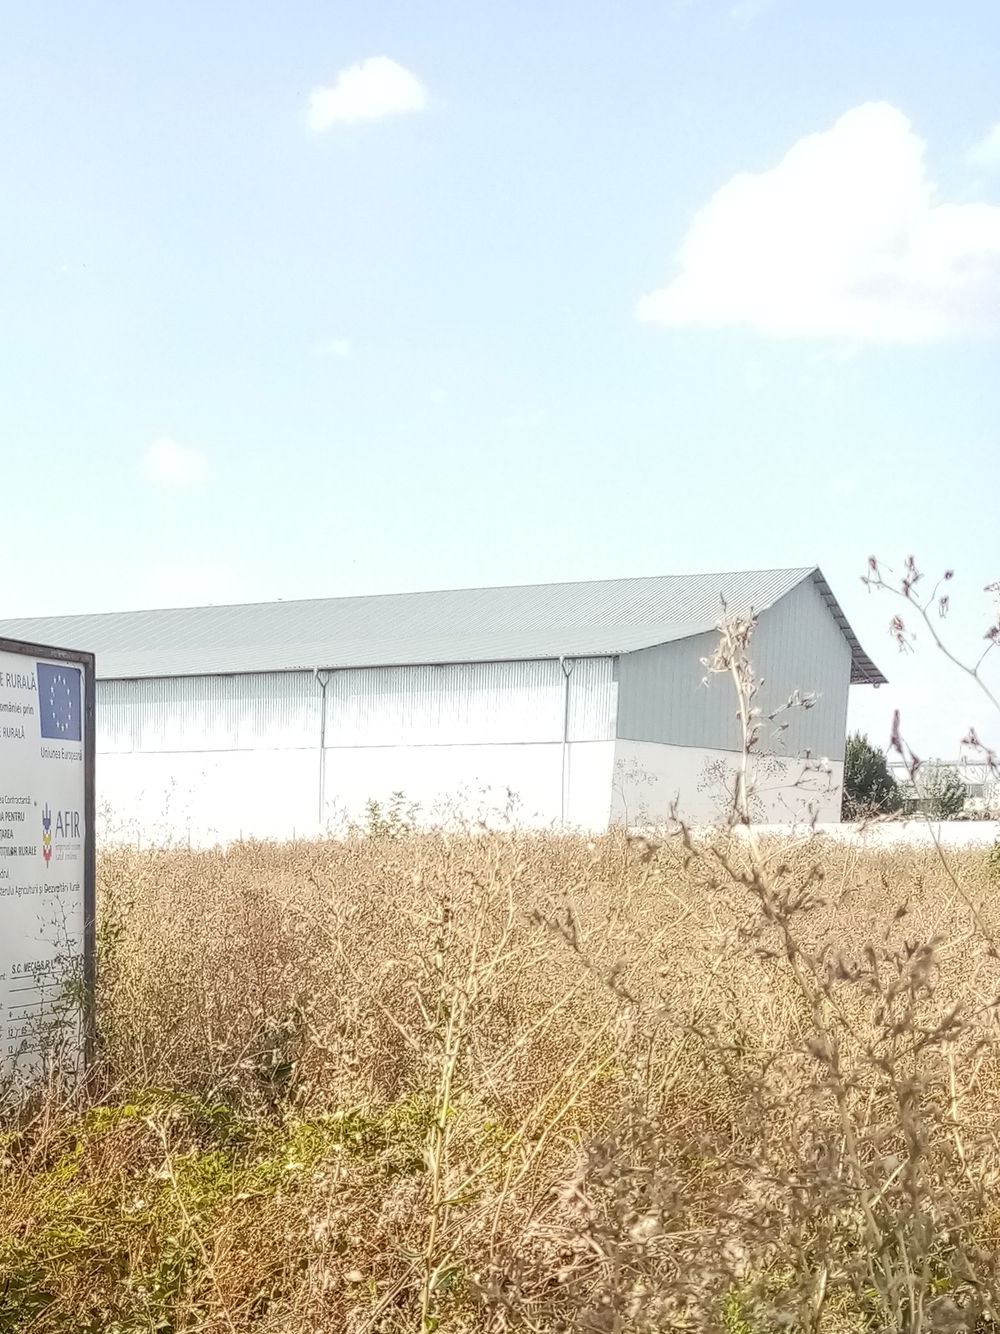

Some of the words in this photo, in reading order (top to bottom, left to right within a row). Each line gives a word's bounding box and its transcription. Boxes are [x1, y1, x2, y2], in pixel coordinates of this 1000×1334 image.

[6, 672, 37, 690] RURALĂ
[22, 703, 34, 716] prin
[2, 725, 25, 739] RURALĂ
[40, 747, 60, 759] Uniunea
[5, 811, 24, 821] PENTRU
[55, 811, 80, 838] AFIR
[18, 846, 36, 855] RURALE
